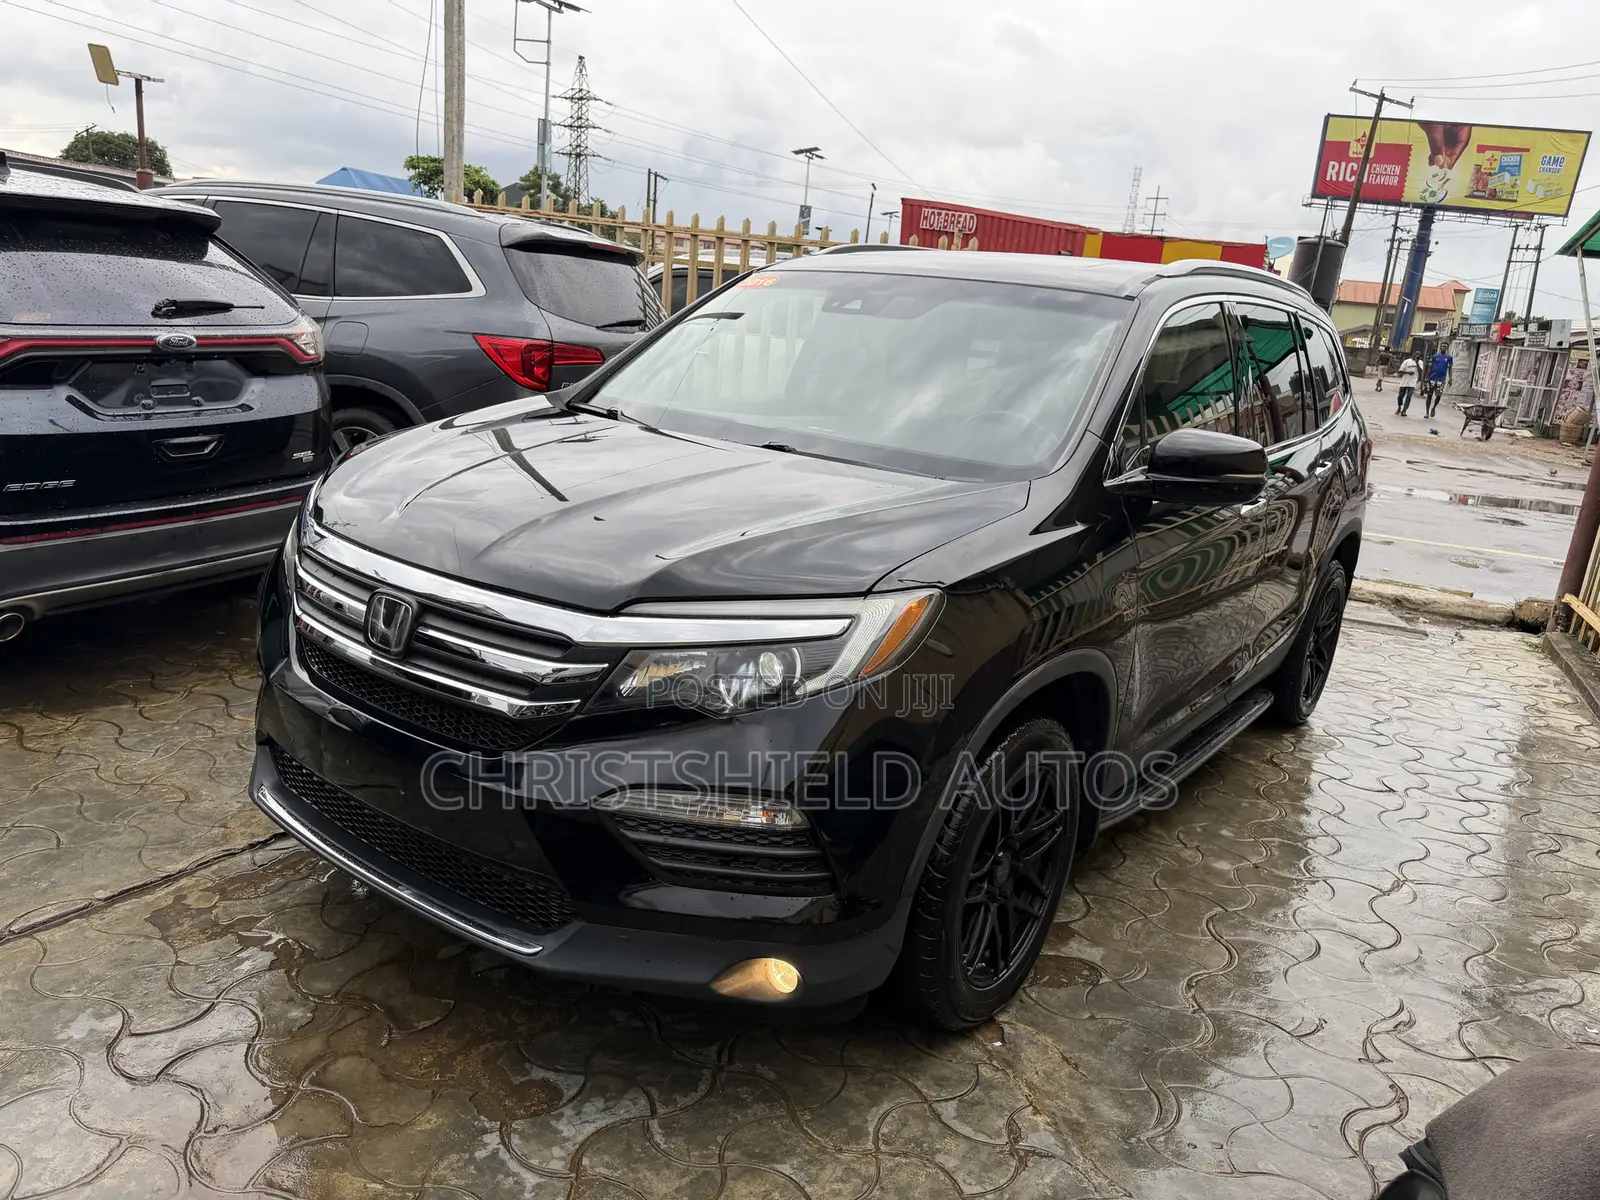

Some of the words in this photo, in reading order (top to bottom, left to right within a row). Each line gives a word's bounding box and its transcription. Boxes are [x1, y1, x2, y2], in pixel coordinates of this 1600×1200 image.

[1370, 163, 1401, 175] CHICKEN
[1368, 174, 1399, 186] FLAVOUR
[2, 479, 76, 492] EDGE
